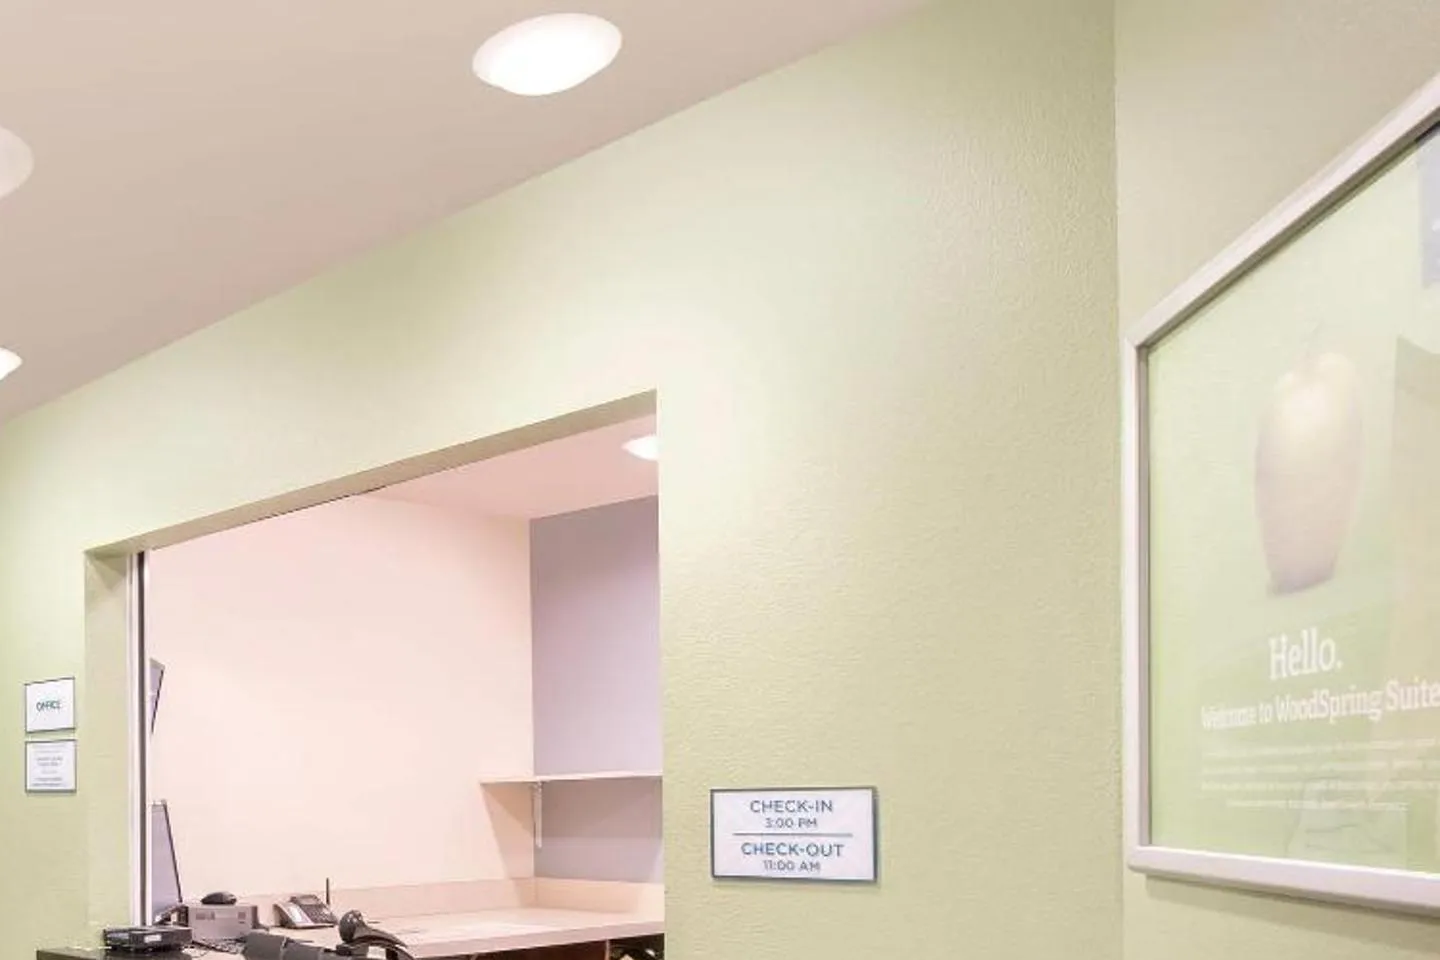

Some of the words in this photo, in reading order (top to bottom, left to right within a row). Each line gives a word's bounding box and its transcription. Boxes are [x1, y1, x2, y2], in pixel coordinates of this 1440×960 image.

[1269, 627, 1343, 681] Hello.
[1259, 702, 1273, 724] to
[1276, 685, 1383, 724] WoodSpring
[750, 799, 833, 813] CHECK-IN
[765, 817, 794, 829] 3:00
[798, 818, 817, 829] PM
[740, 842, 845, 857] CHECK-OUT
[763, 860, 795, 871] 11:00
[799, 861, 820, 873] AM
